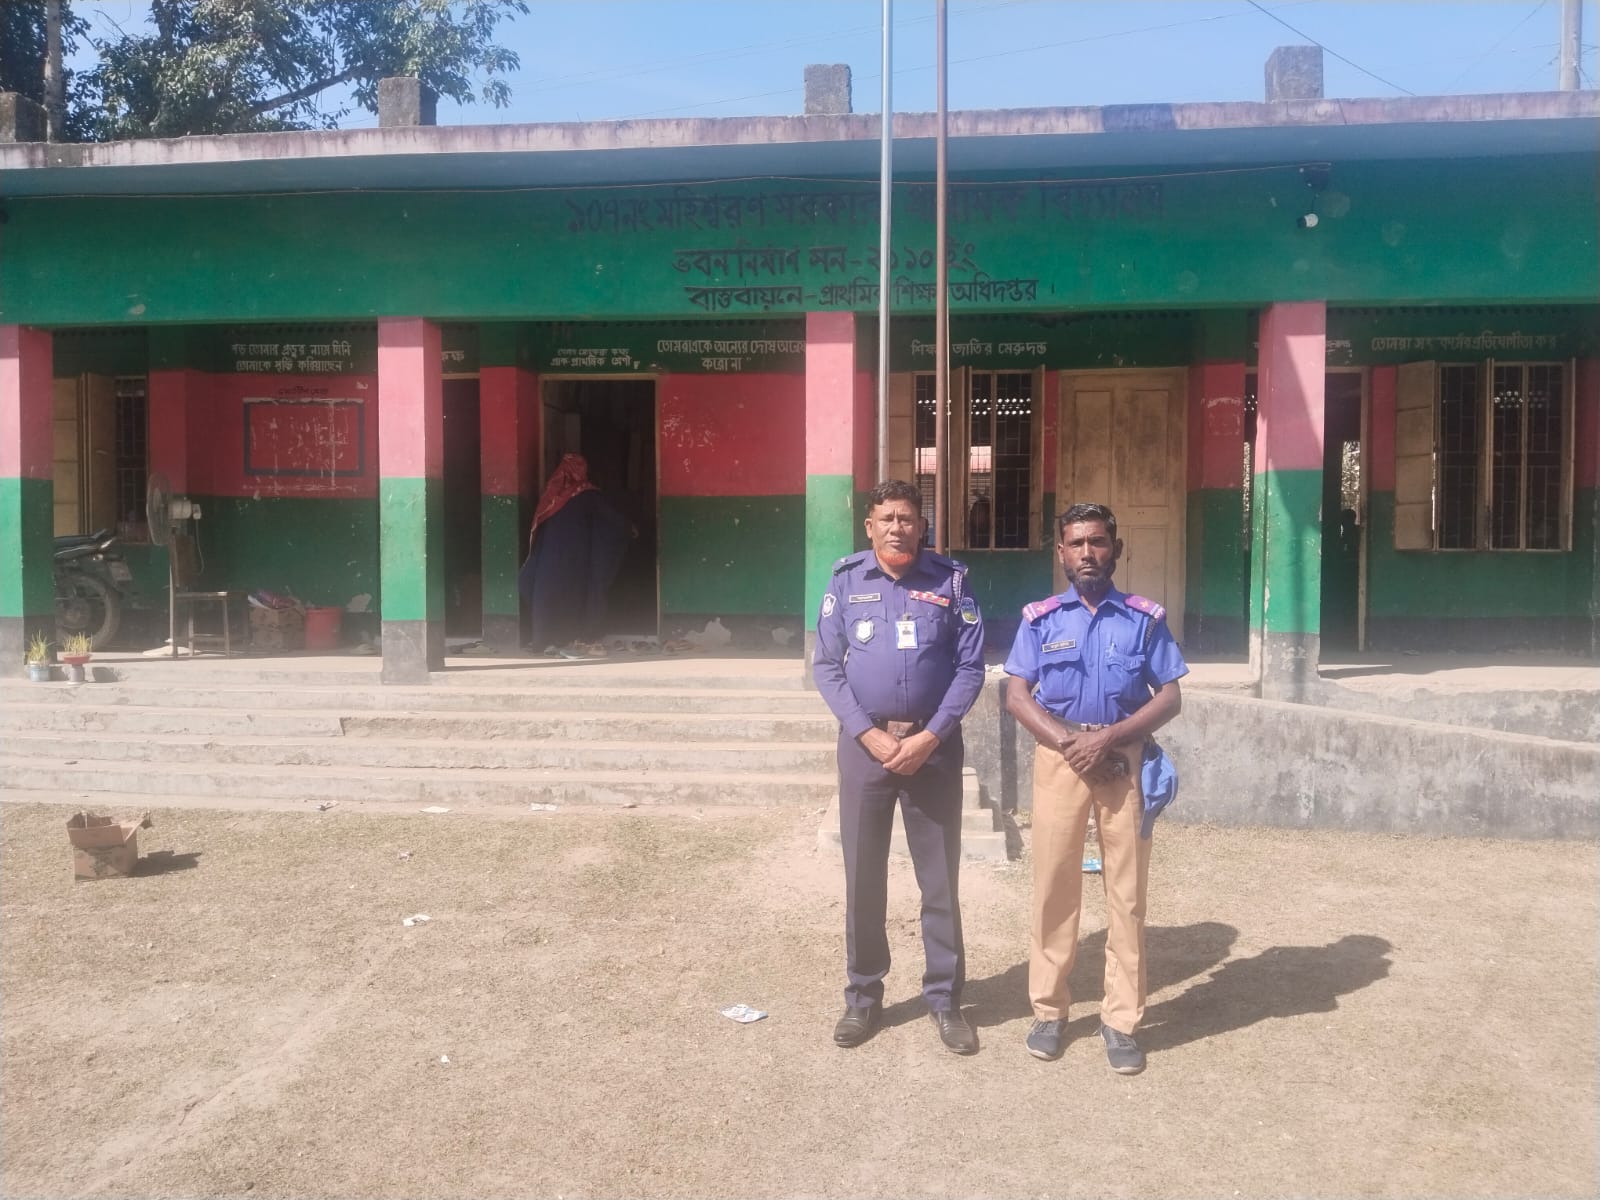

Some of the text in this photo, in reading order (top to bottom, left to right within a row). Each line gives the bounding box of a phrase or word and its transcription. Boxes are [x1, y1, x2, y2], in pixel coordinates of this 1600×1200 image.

[671, 247, 729, 277] ভবন
[950, 271, 1039, 304] অধিদপ্তর
[656, 339, 691, 353] তোমরা
[952, 338, 993, 357] জাতির
[701, 357, 728, 371] করো
